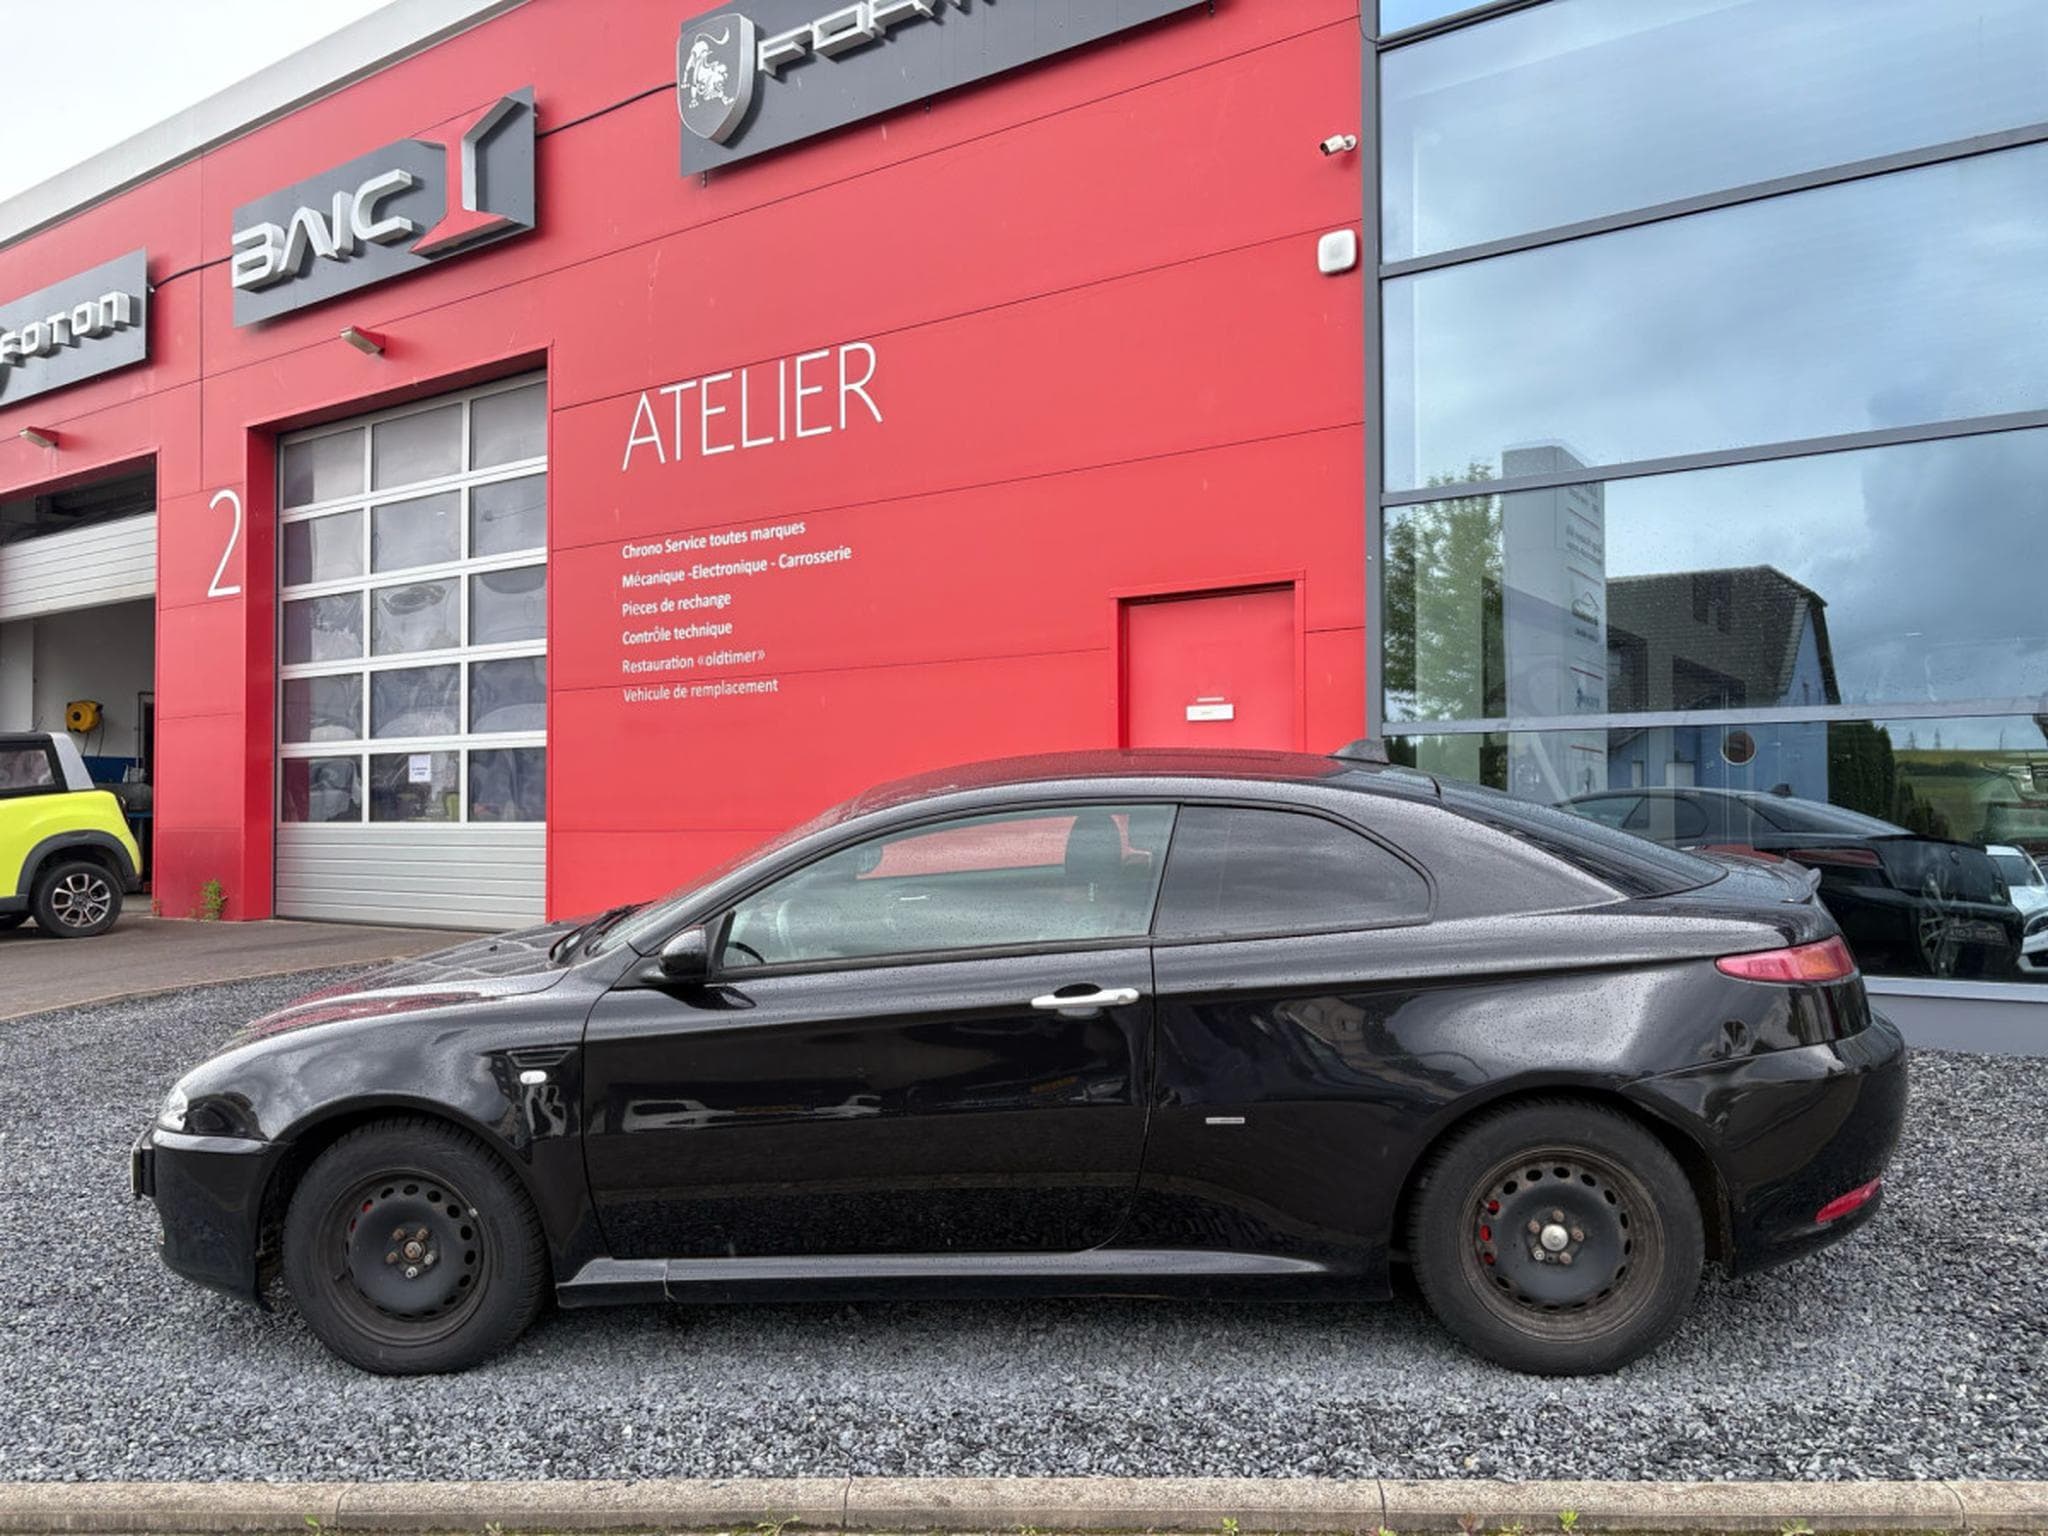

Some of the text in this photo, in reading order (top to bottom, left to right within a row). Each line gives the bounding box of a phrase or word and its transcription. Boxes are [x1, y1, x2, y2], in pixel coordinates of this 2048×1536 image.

[757, 0, 972, 77] FOR
[231, 168, 413, 289] BAIC
[0, 291, 131, 365] FOTON
[622, 342, 883, 471] ATELIER
[207, 489, 241, 597] 2
[622, 521, 806, 559] Chrono Service toutes marques
[622, 568, 685, 588] Mécanique
[778, 545, 852, 570] Carrosserie
[660, 597, 675, 612] de
[678, 593, 731, 610] rechange
[622, 622, 733, 645] Contrôle technique
[622, 655, 694, 673] Restauration
[673, 683, 689, 699] de
[691, 679, 779, 699] remplacement
